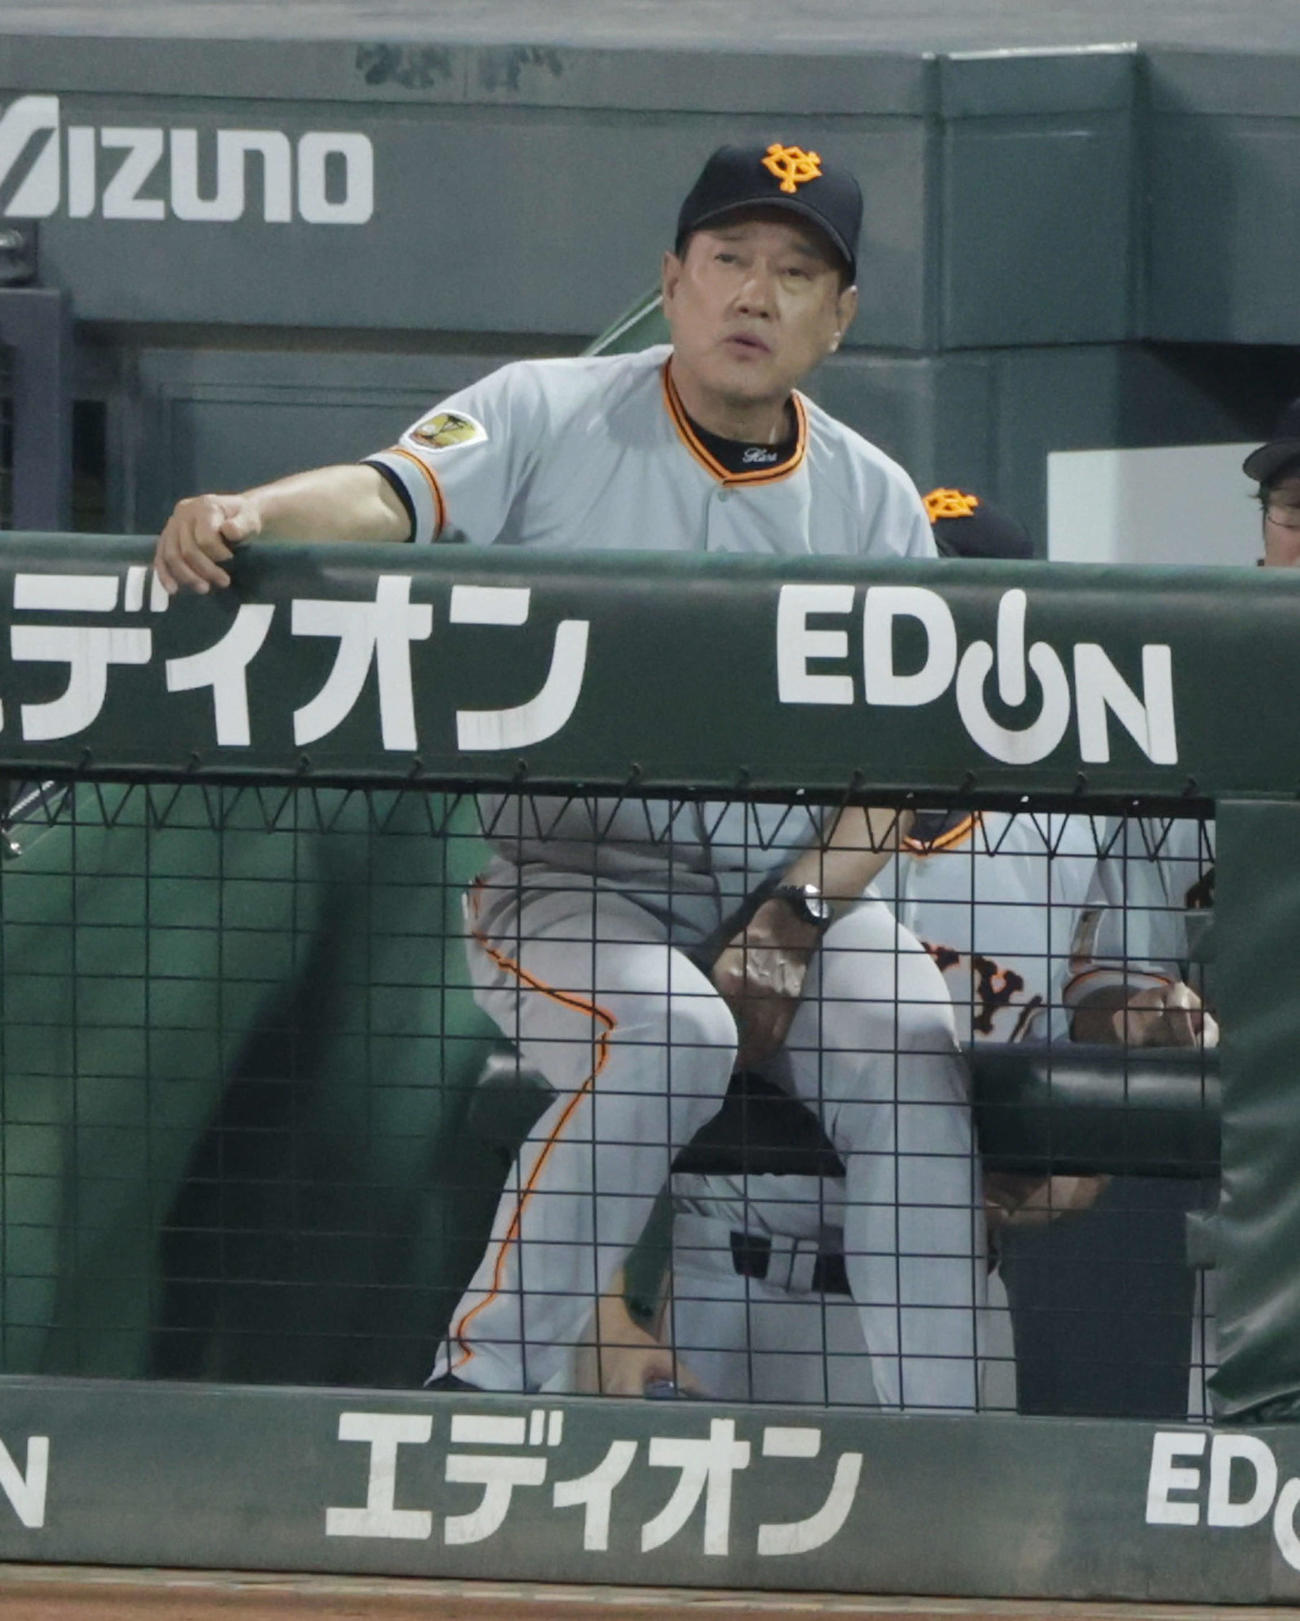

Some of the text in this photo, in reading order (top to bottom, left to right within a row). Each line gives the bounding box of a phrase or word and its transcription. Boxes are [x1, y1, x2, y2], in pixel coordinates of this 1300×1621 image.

[0, 566, 590, 752] ディオン
[776, 584, 1178, 765] EDION
[325, 1409, 863, 1556] エディオン
